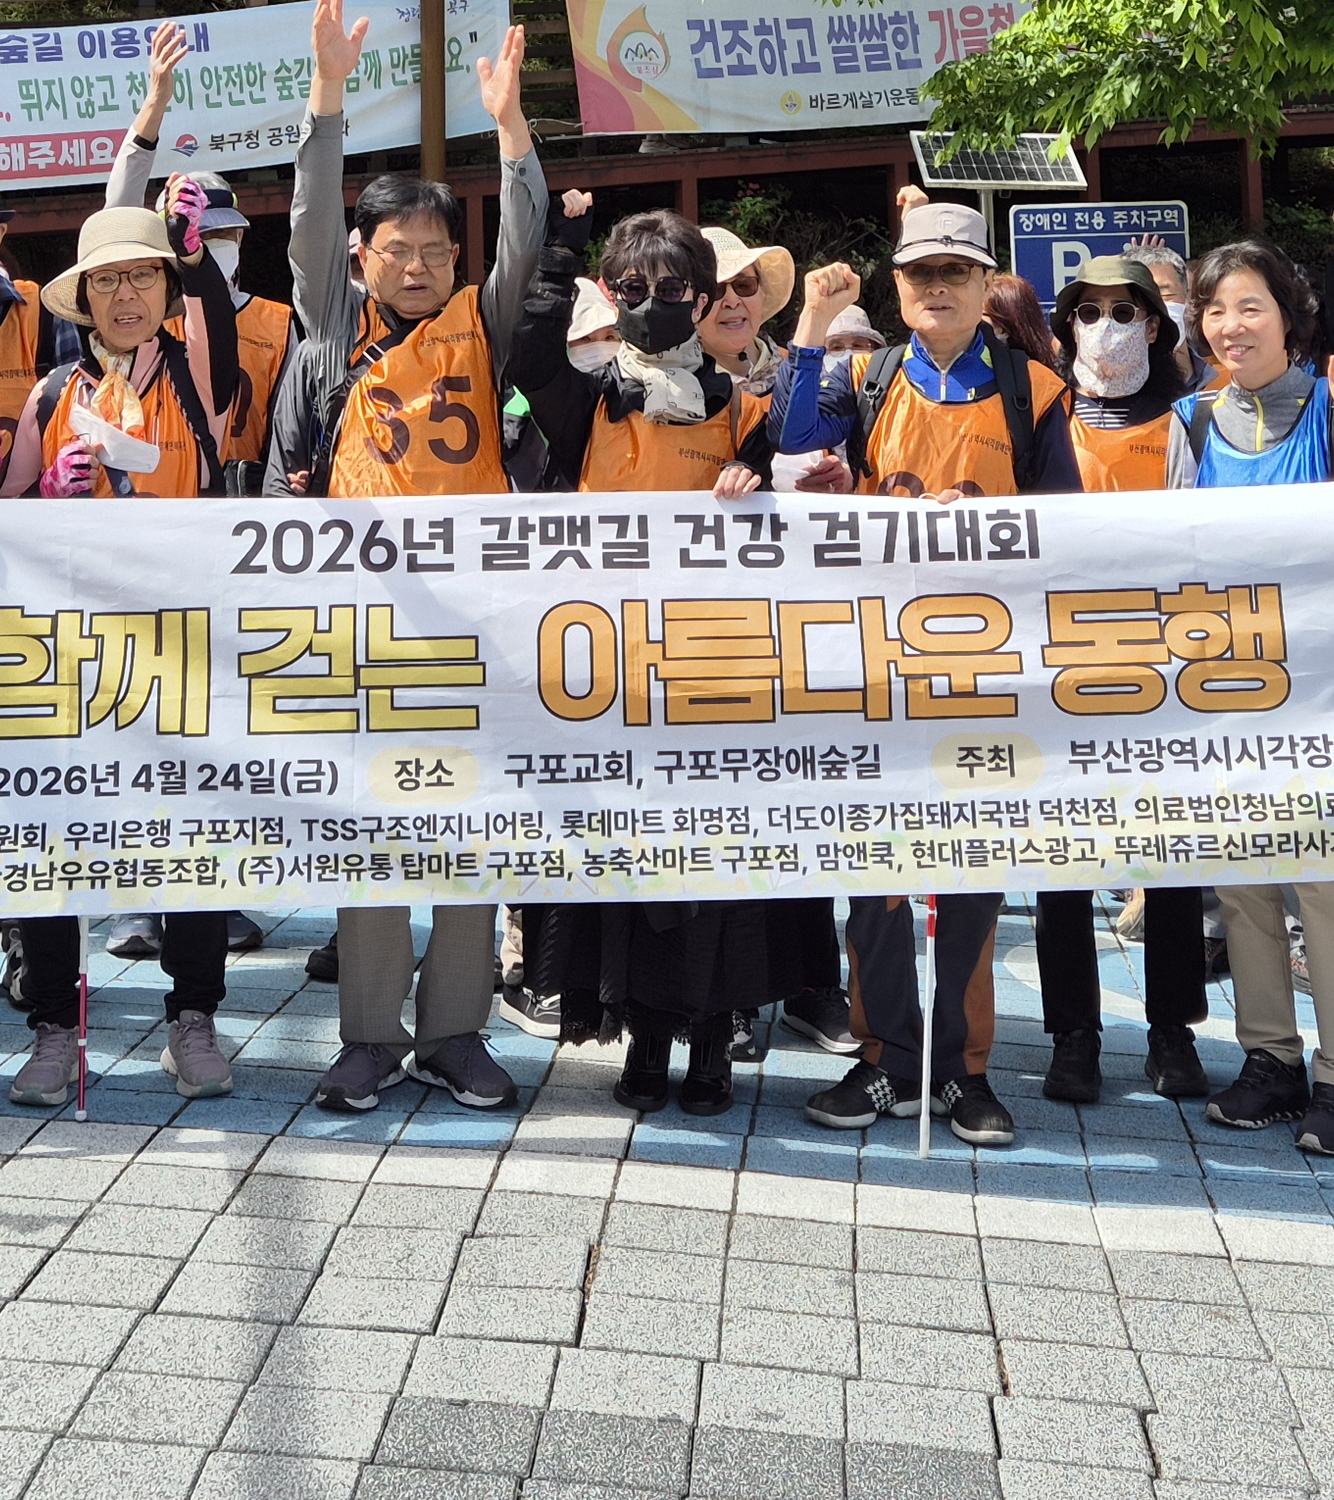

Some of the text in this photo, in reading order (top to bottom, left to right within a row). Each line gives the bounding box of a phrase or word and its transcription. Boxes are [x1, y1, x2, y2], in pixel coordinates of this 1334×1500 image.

[686, 16, 821, 80] 건조하고
[826, 9, 923, 75] 쌀쌀한
[17, 76, 68, 123] 뛰지
[70, 74, 121, 120] 않고
[126, 63, 194, 115] 천히
[200, 60, 267, 109] 안전한
[809, 86, 920, 113] 바르게살기운동
[209, 128, 260, 153] 북구청
[1019, 209, 1180, 233] 장애인 전용 주차구역
[230, 508, 1041, 575] 2026년 갈맷길 건강 걷기대회
[237, 601, 486, 734] 걷는
[536, 594, 1022, 727] 아름다운
[1043, 582, 1293, 718] 동행
[130, 759, 188, 794] 4월
[197, 759, 340, 796] 24일(금)
[393, 757, 456, 793] 장소
[503, 749, 646, 791] 구포교회,
[653, 743, 883, 786] 구포무장애숲길
[955, 743, 1017, 779] 주최
[64, 818, 173, 852] 우리은행
[178, 815, 293, 849] 구포지점,
[300, 811, 552, 843] TSS구조엔지니어링,
[560, 808, 668, 841] 롯데마트
[672, 807, 759, 838] 화명점,
[768, 799, 1031, 835] 더도이종가집돼지국밥
[1039, 797, 1128, 829] 덕천점,
[237, 853, 394, 886] (주)서원유통
[400, 850, 481, 881] 탑마트
[486, 848, 574, 882] 구포점,
[580, 844, 715, 878] 농축산마트
[721, 843, 808, 876] 구포점,
[815, 839, 903, 873] 맘앤쿡,
[911, 835, 1107, 869] 현대플러스광고,
